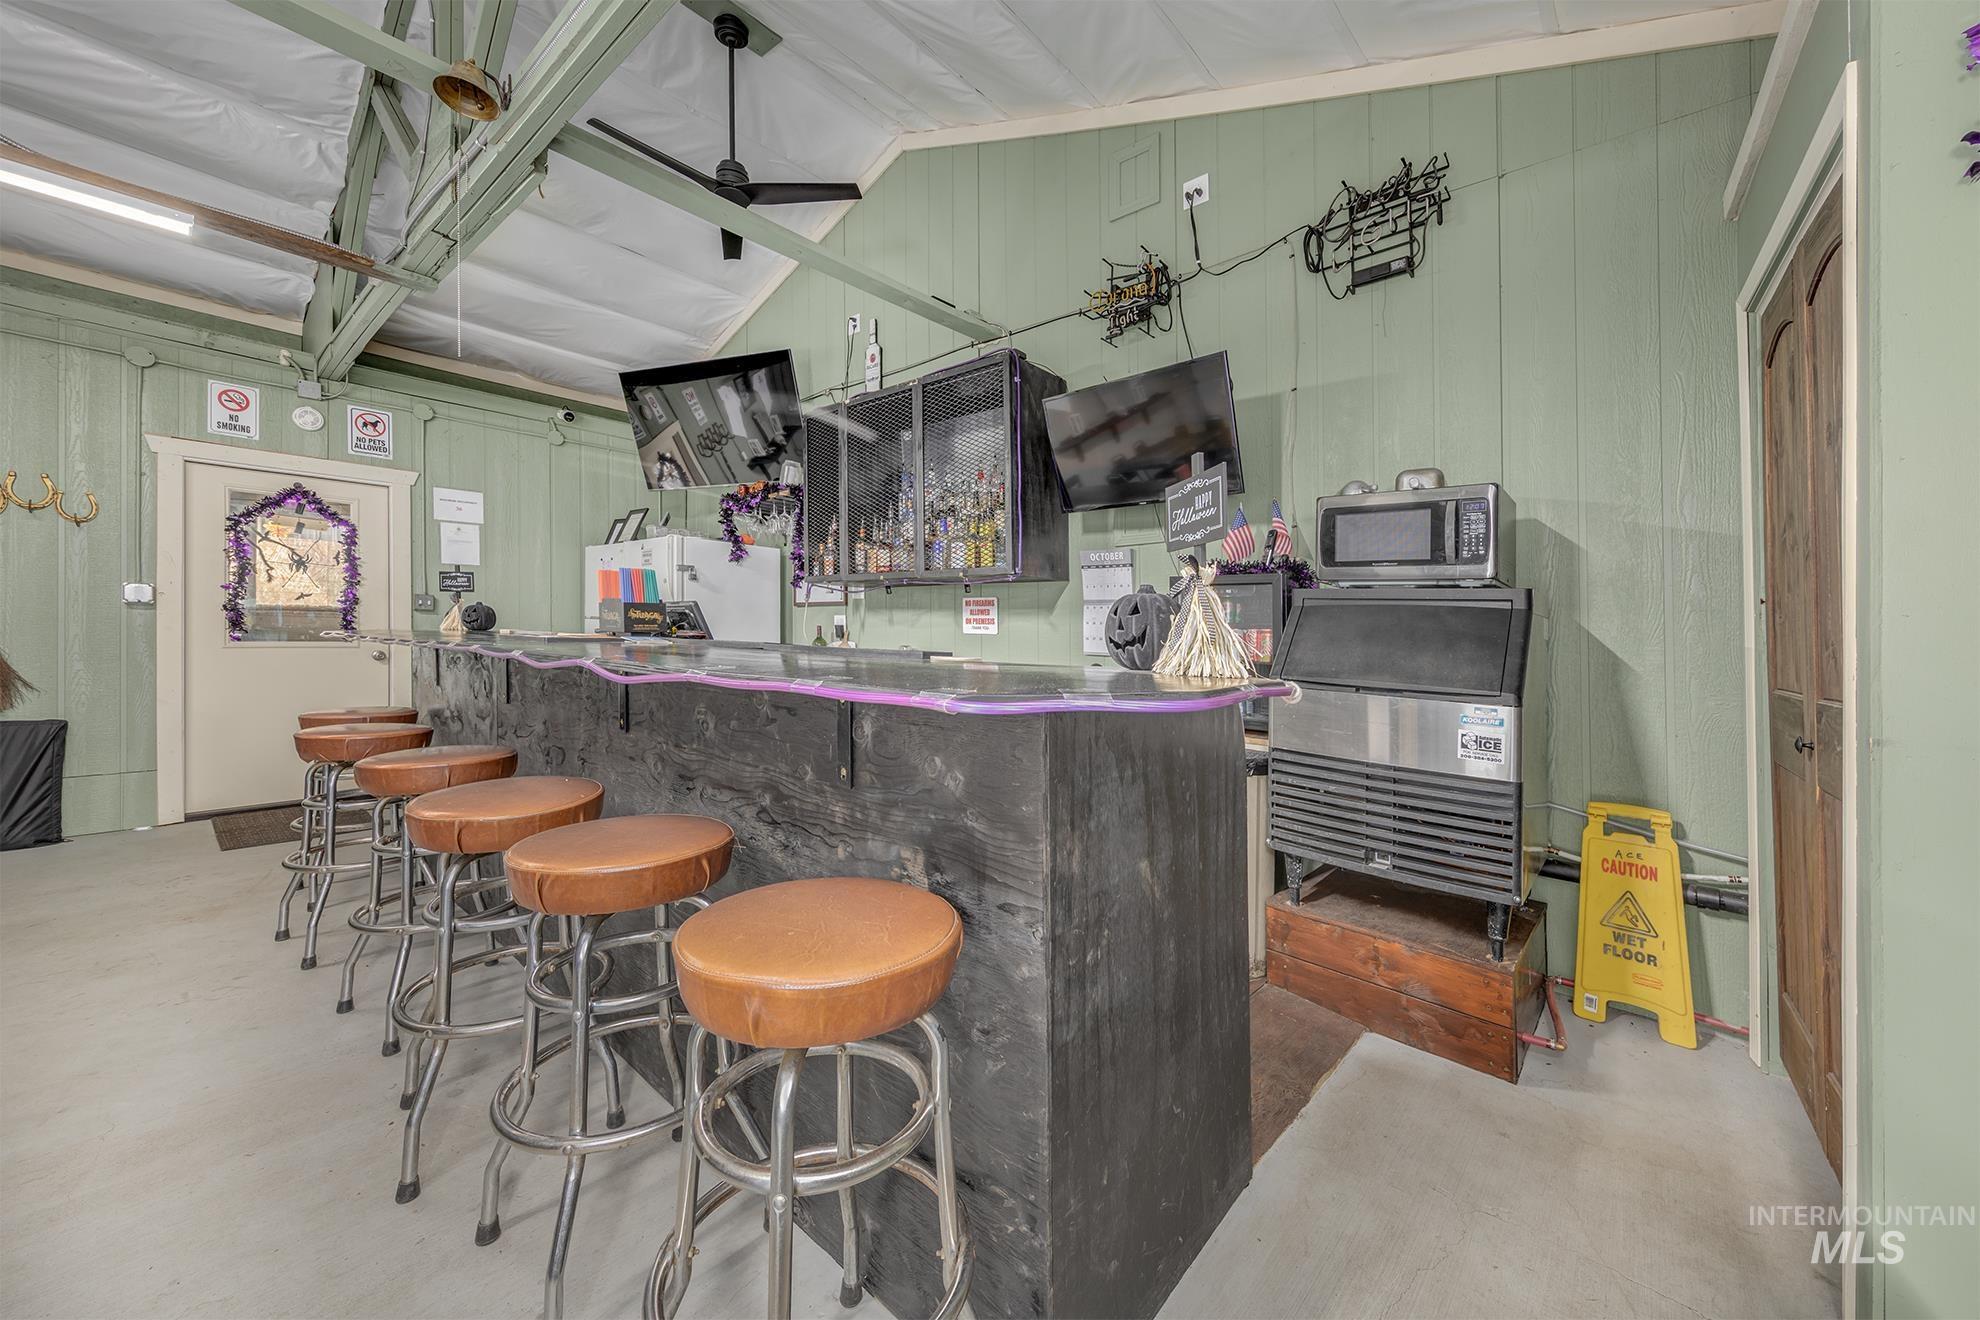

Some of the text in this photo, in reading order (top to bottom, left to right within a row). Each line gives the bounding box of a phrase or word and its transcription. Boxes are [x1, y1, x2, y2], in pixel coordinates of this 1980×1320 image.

[228, 414, 239, 423] NO
[216, 421, 251, 434] SMOKING
[356, 436, 386, 447] NO PETS
[354, 442, 388, 454] ALLOWED
[1194, 490, 1212, 510] HAPPY
[1171, 506, 1217, 531] Halloween
[1090, 552, 1124, 561] OCTOBER
[965, 599, 995, 607] NO FIREARMS
[1462, 717, 1501, 726] KOOLAIRE
[1478, 740, 1502, 750] ICE
[1601, 857, 1658, 882] CAUTION
[1612, 930, 1647, 949] WET
[1602, 943, 1659, 967] FLOOR
